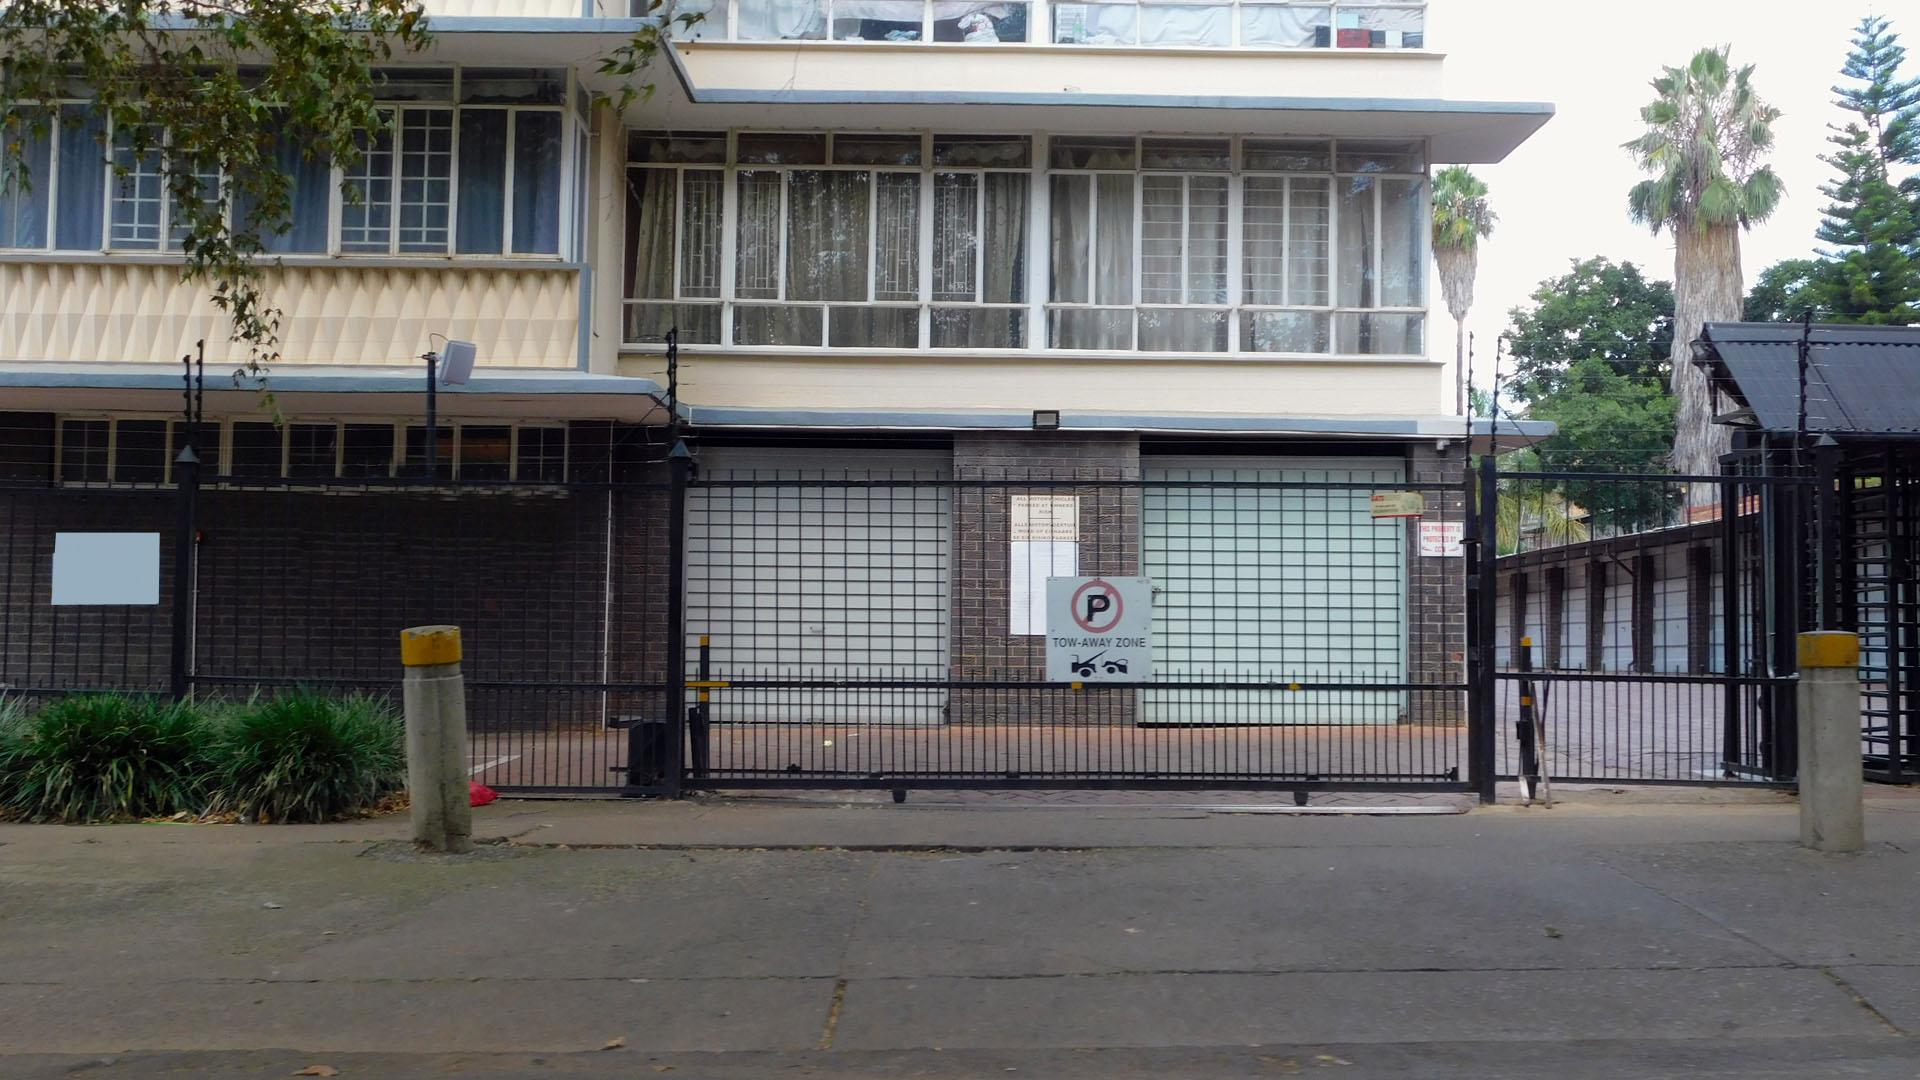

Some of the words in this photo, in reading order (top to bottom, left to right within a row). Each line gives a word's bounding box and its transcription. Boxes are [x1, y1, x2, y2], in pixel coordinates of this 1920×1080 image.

[1087, 594, 1110, 622] P
[1052, 637, 1112, 648] TOW-AWAY
[1115, 637, 1147, 648] ZONE
